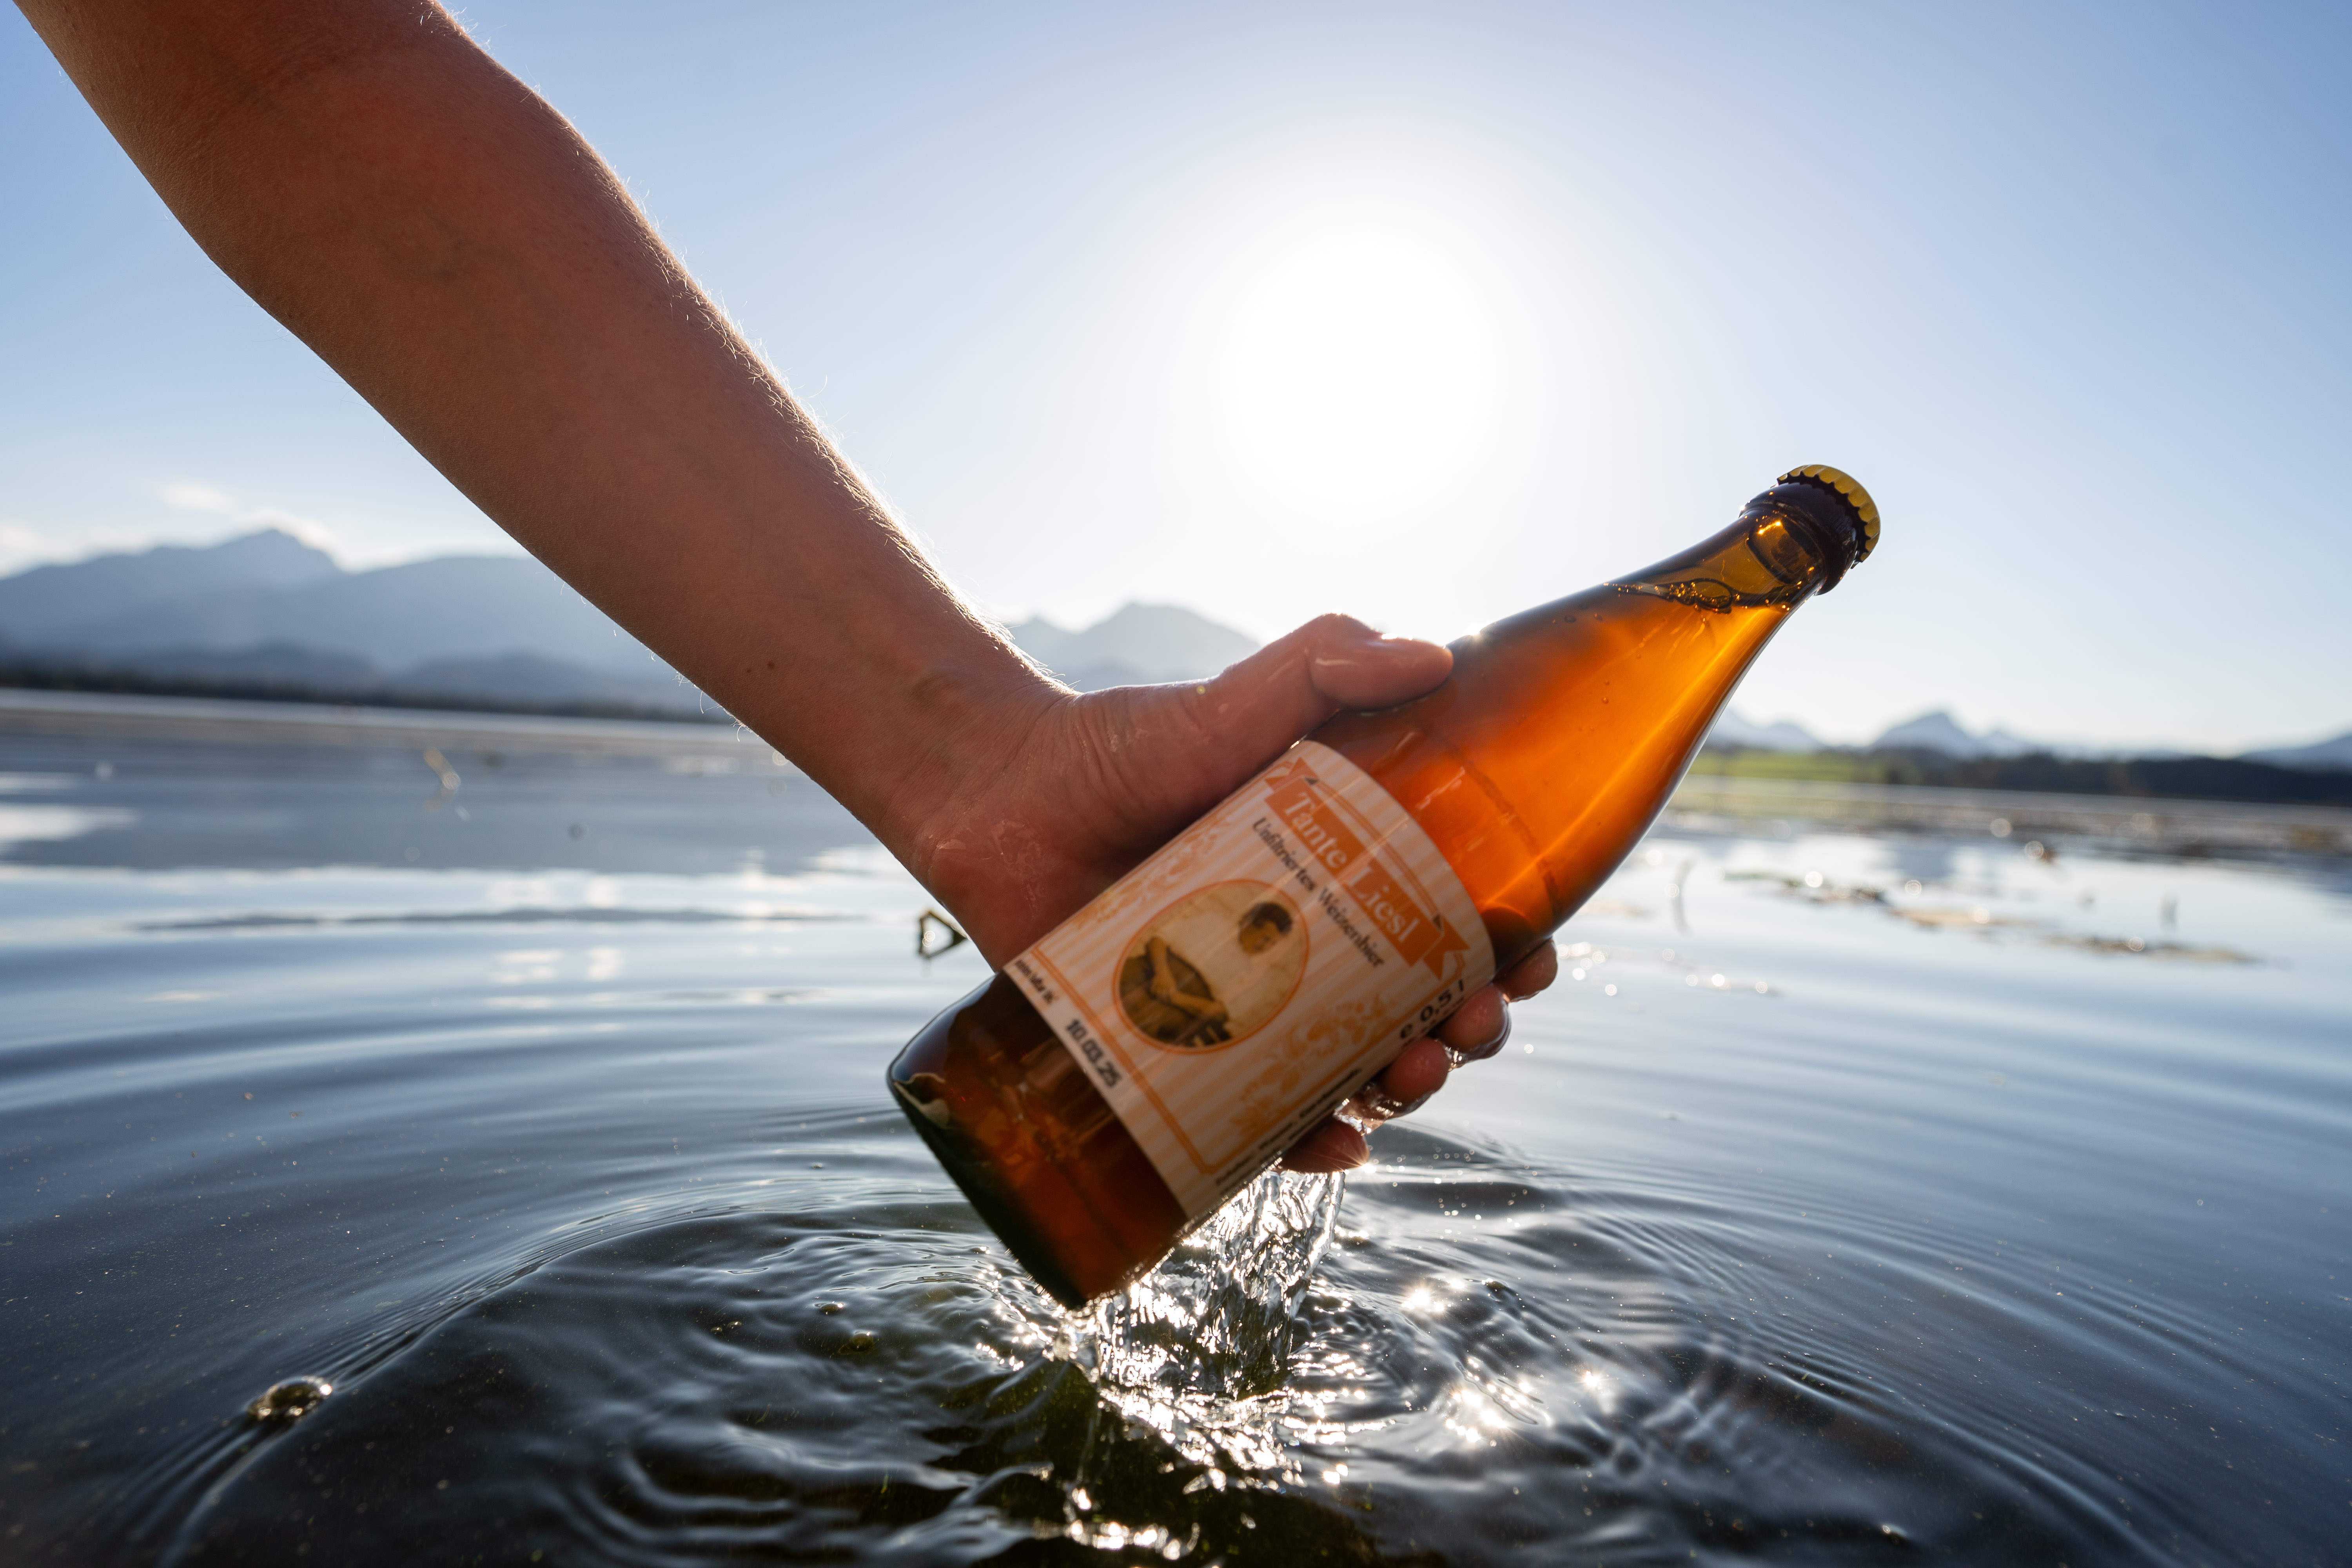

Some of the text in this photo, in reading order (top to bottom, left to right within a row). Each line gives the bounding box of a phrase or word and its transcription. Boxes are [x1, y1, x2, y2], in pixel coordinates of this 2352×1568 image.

[1252, 816, 1385, 968] Unfiltriertes Weizenbier
[1285, 791, 1420, 942] Tante Liesl
